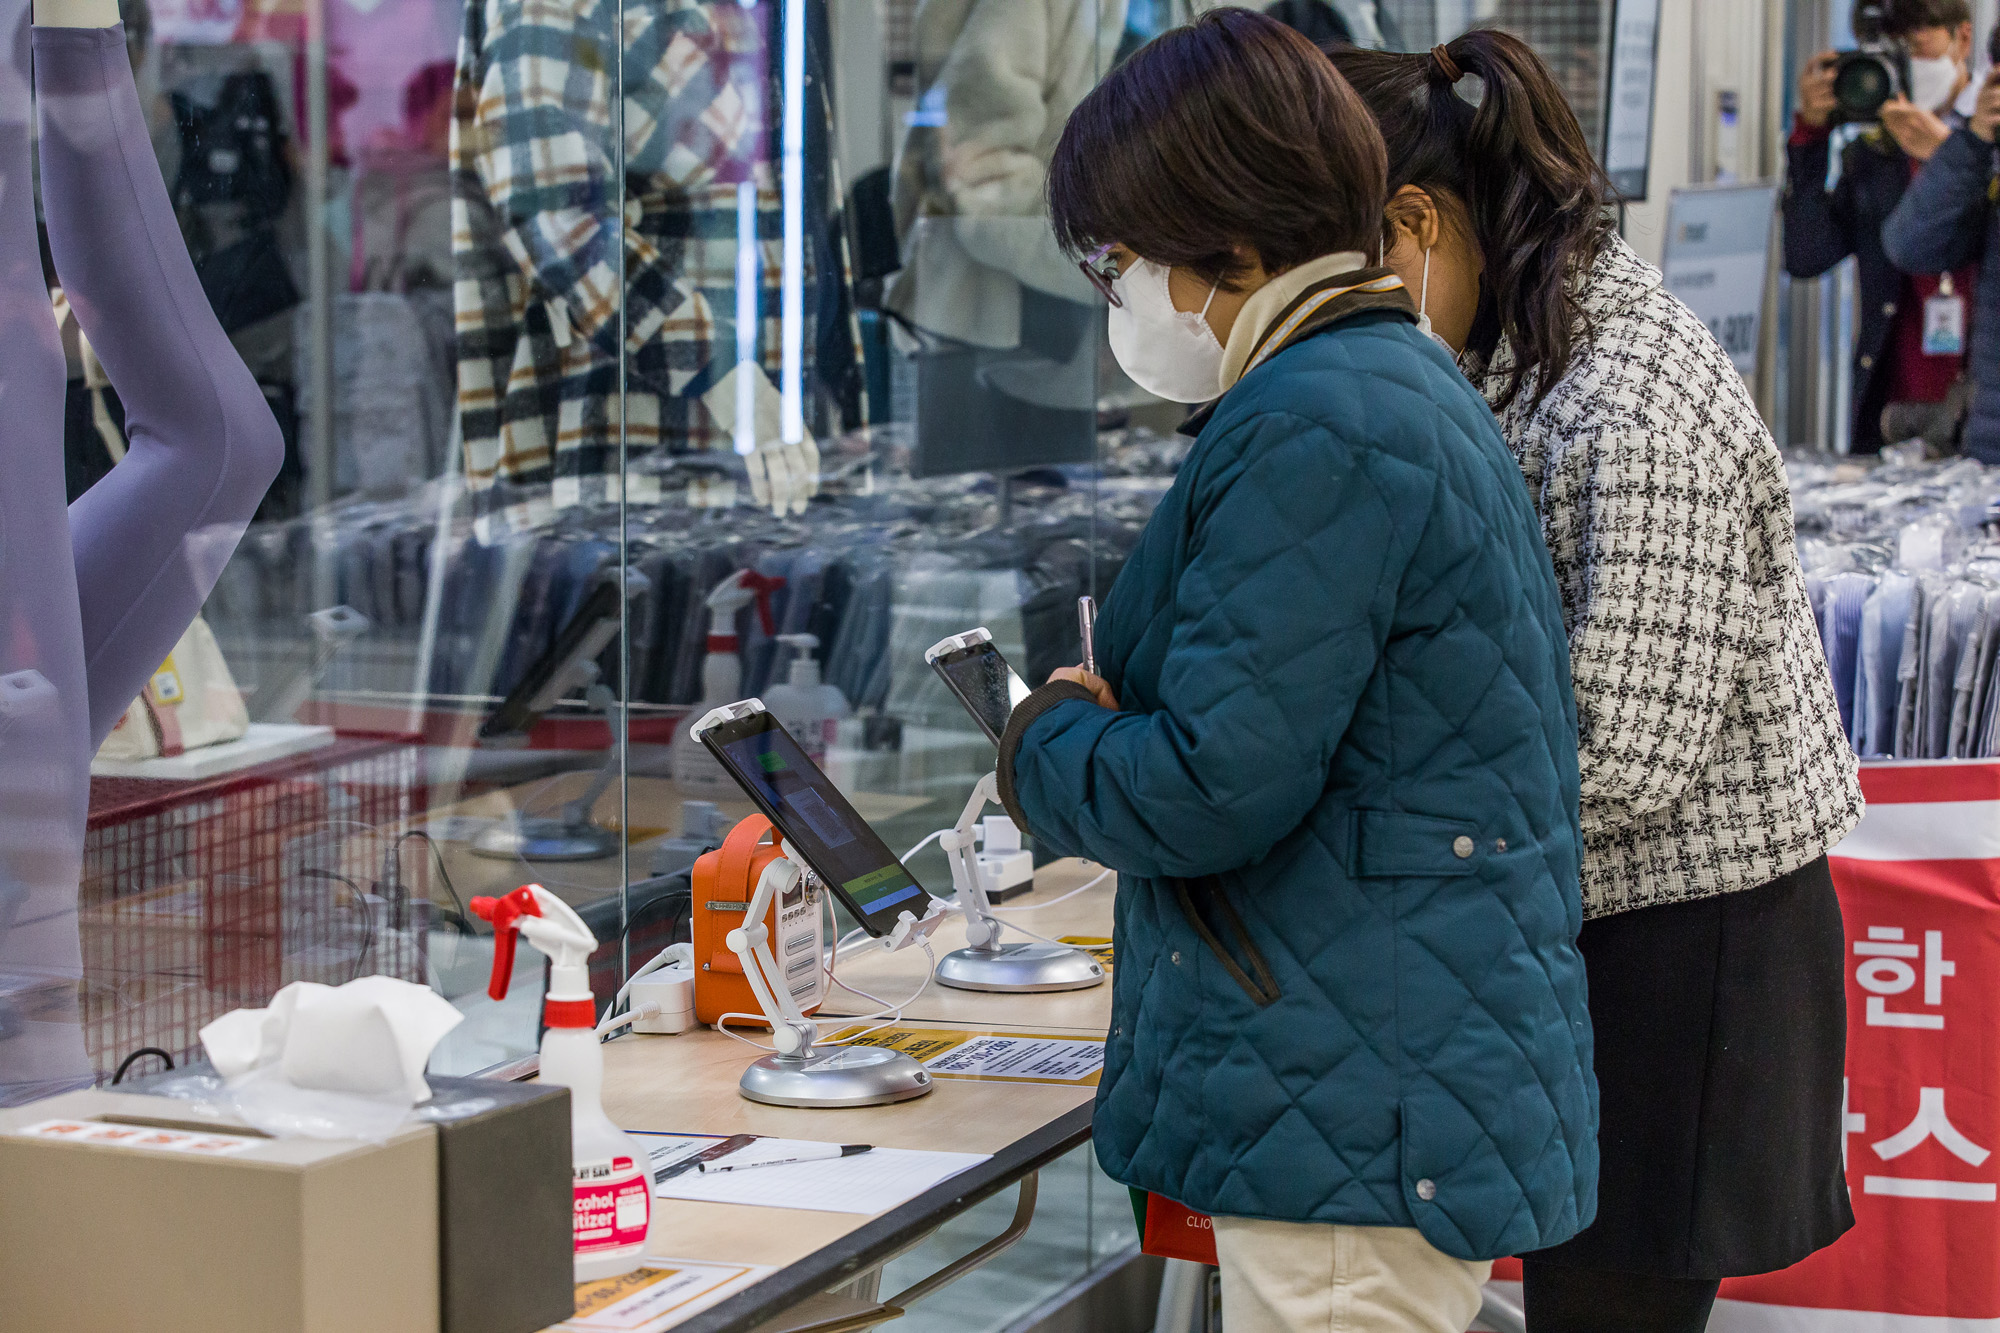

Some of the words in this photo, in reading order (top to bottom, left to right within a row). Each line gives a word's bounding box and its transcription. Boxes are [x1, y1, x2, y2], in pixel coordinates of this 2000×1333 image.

[1853, 926, 1956, 1030] 한
[1841, 1076, 1998, 1203] 스
[573, 1191, 615, 1212] cohol
[573, 1211, 615, 1230] itizer
[1186, 1215, 1212, 1230] CLIO
